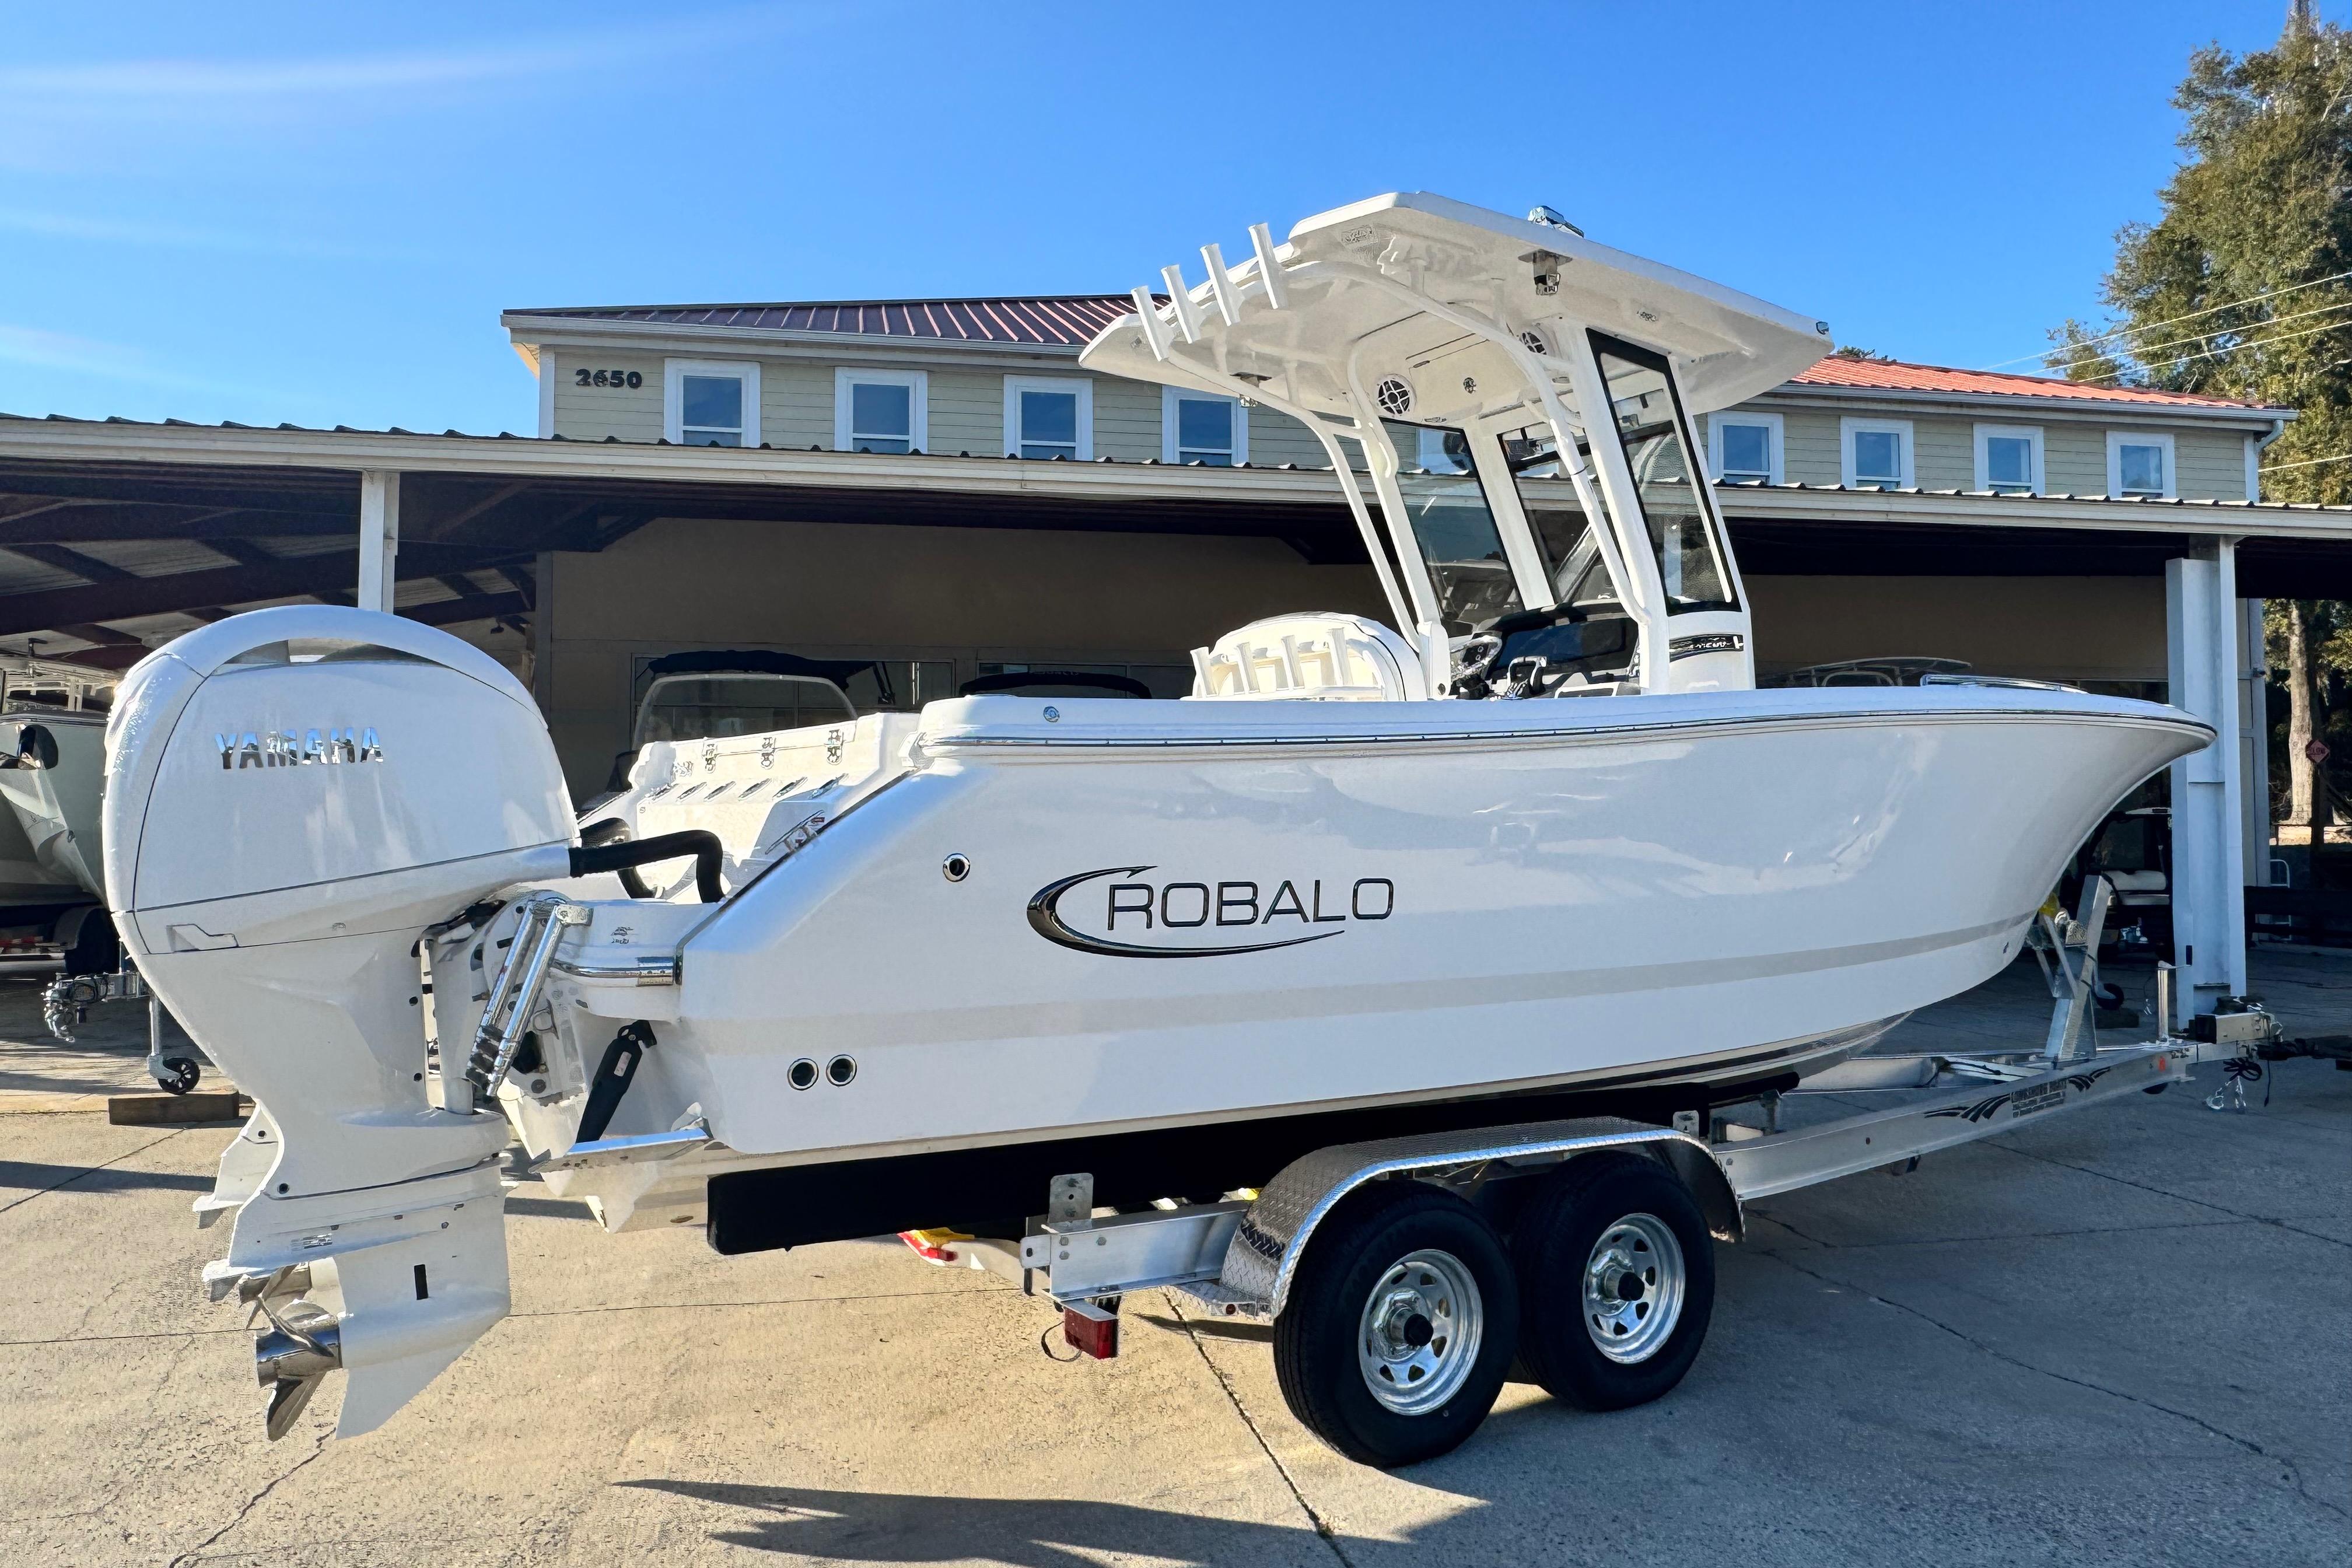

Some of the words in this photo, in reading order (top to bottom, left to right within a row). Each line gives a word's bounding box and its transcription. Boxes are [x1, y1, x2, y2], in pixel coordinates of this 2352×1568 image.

[576, 369, 642, 388] 2650
[215, 727, 383, 769] YAMAHA
[1107, 878, 1394, 930] ROBALO
